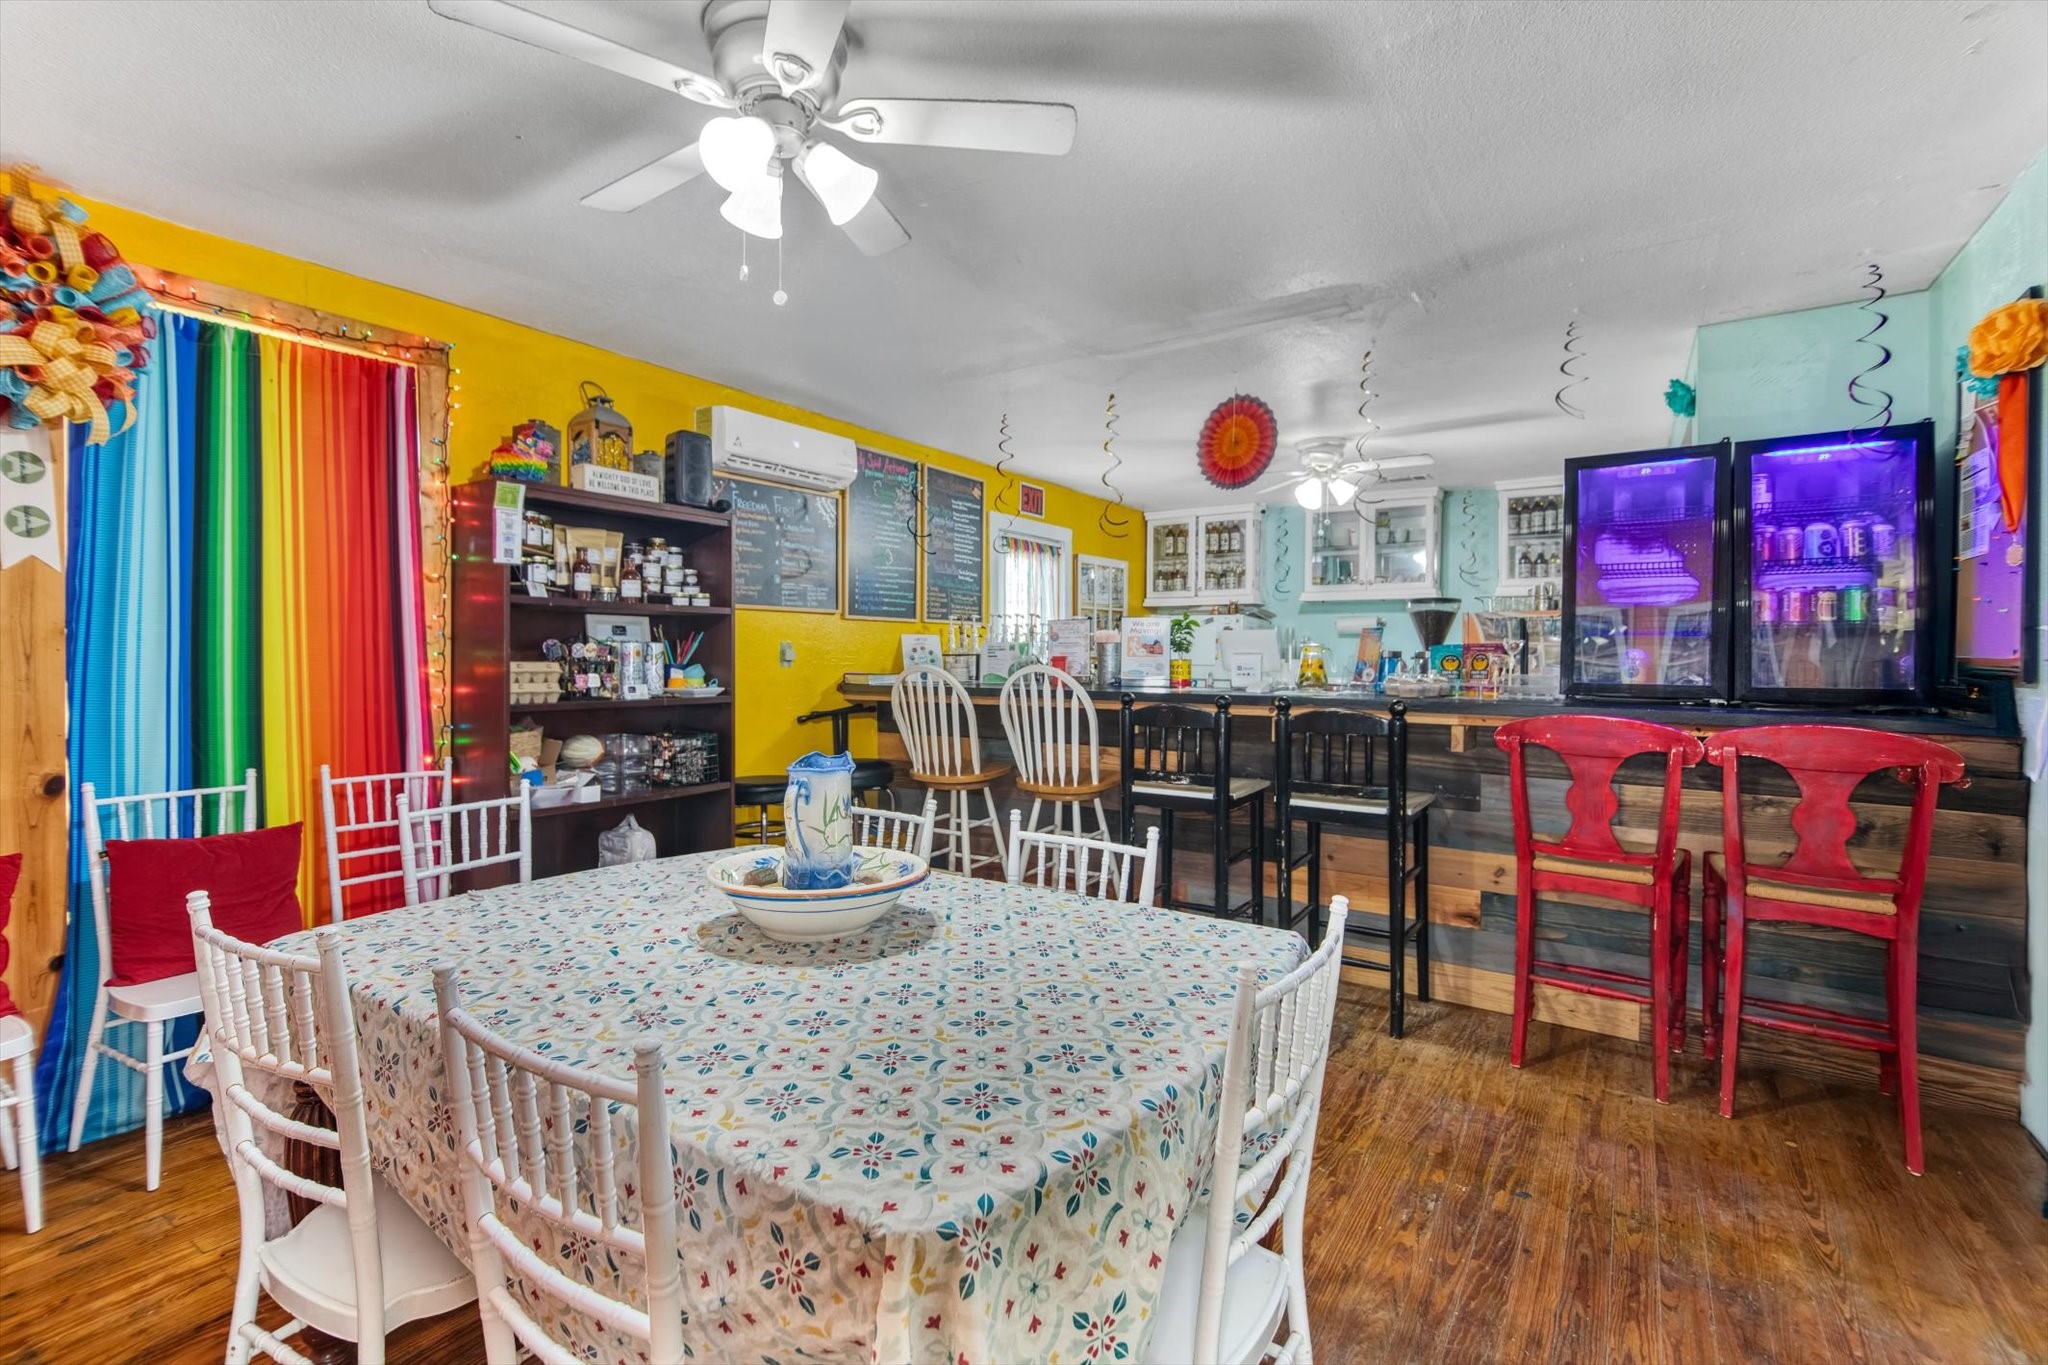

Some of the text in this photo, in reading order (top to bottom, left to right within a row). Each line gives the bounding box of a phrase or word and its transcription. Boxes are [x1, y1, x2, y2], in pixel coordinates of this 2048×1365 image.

[589, 479, 596, 487] BE
[597, 481, 620, 492] WELCOME
[628, 486, 639, 495] THIS
[640, 488, 655, 498] PLACE
[593, 471, 619, 481] ALMIGHTY
[620, 475, 630, 483] GOD
[639, 479, 651, 488] LOVE
[1022, 485, 1043, 514] EXIT
